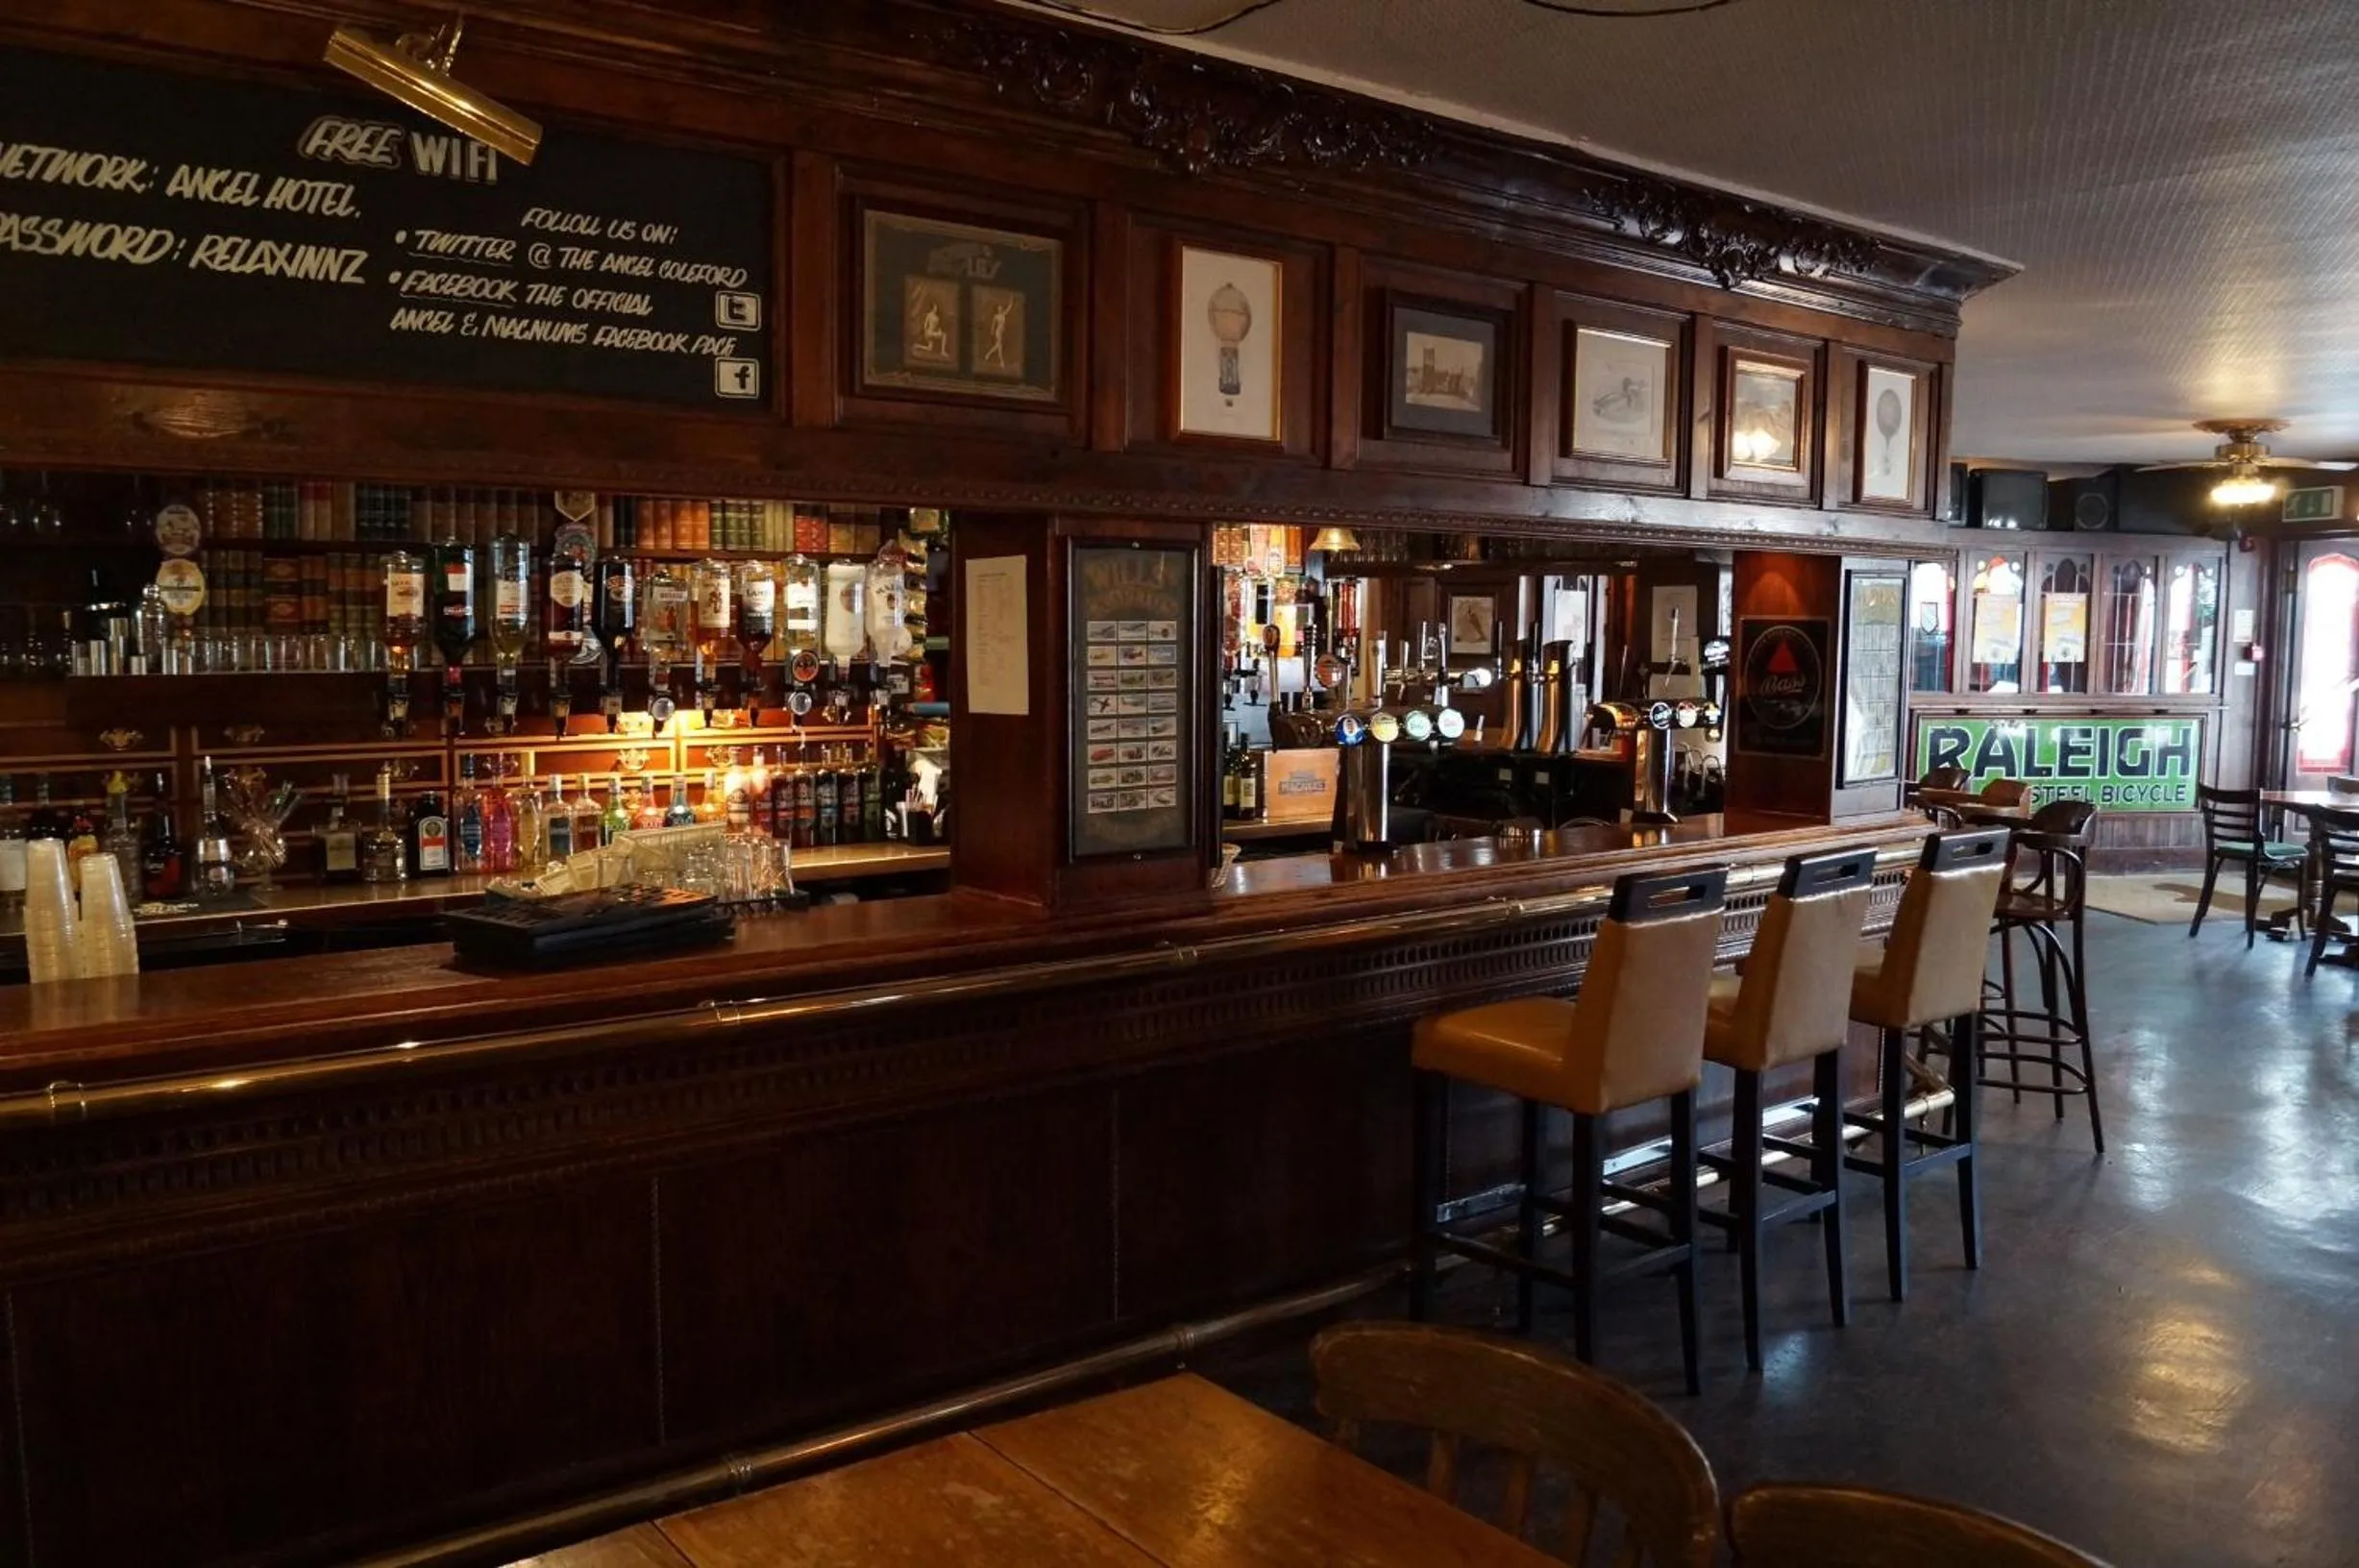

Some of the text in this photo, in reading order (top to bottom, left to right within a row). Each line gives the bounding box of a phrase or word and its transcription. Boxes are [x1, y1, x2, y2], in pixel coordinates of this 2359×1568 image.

[301, 117, 498, 185] FREE WIFI
[166, 163, 260, 208] ANGEL
[262, 176, 363, 219] HOTEL.
[606, 218, 638, 241] US
[188, 233, 369, 284] RELAXINNZ
[414, 229, 749, 289] TWITTER @ THE ANGEL COLEFORD
[400, 269, 654, 317] FACEBOOK THE OFFICIAL
[389, 306, 739, 356] ANGEL & MAGNUMS FACEBOOK PAGE
[1928, 724, 2194, 780] RALEIGH
[2101, 784, 2187, 805] BICYCLE
